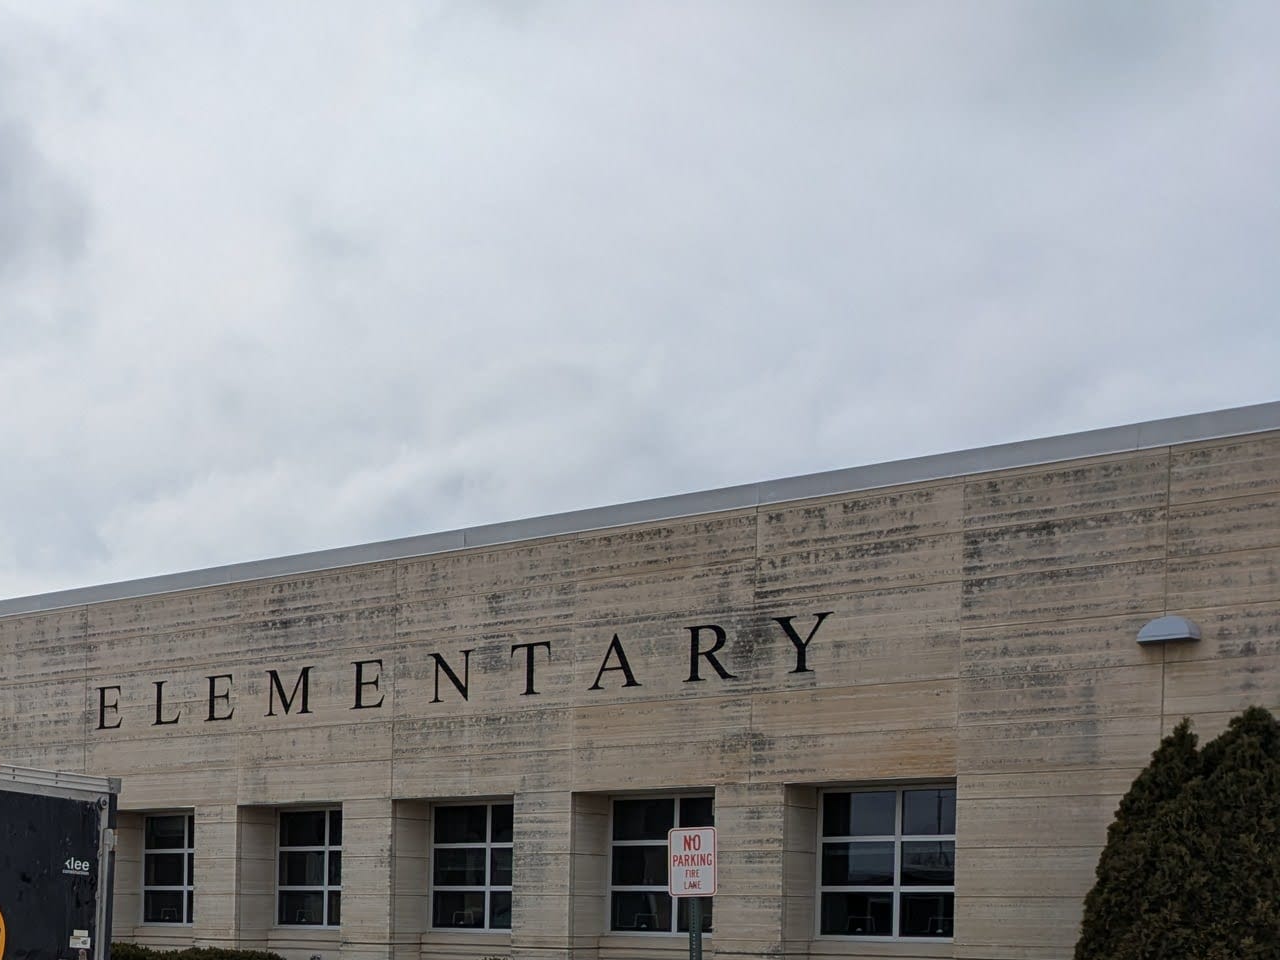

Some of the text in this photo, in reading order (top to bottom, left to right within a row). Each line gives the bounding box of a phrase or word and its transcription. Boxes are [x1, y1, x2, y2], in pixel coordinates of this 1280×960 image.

[95, 611, 835, 731] ELEMENTARY
[683, 834, 701, 851] NO
[672, 853, 713, 867] PARKING
[685, 869, 700, 878] FIRE
[684, 880, 702, 889] LANE
